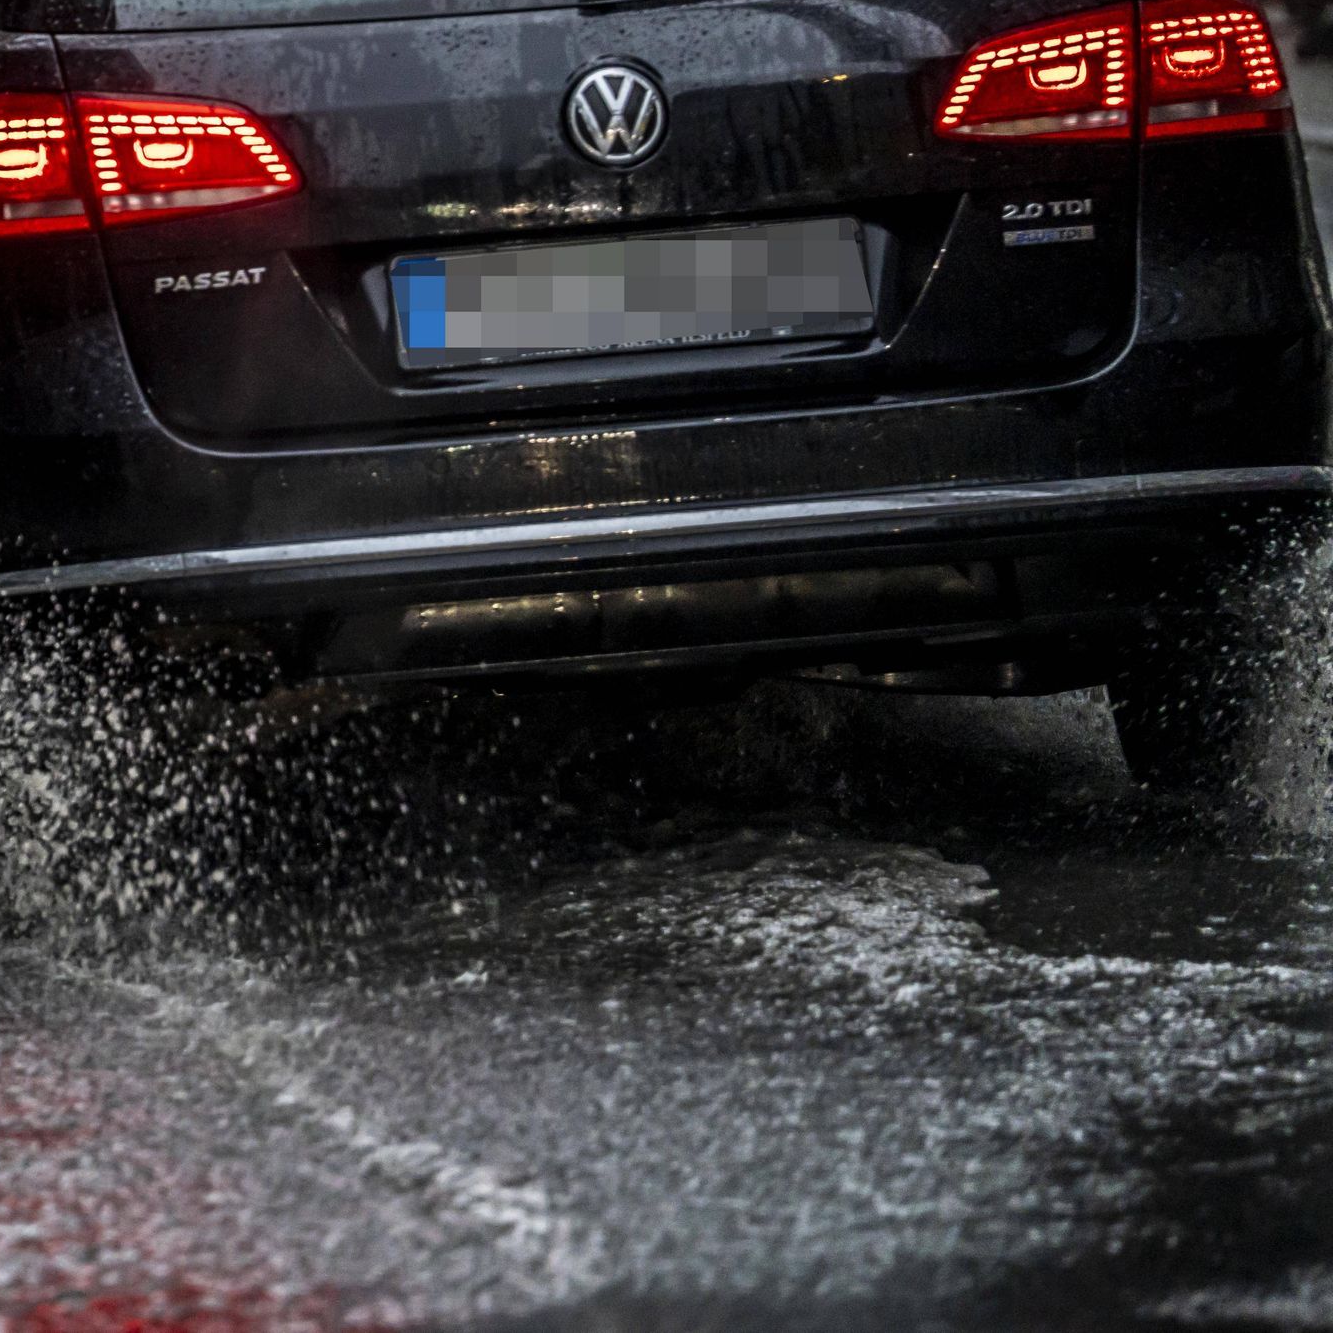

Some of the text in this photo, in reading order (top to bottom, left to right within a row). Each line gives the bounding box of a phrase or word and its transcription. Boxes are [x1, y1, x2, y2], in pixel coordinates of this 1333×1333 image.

[1002, 198, 1092, 220] 2.0 TDI
[154, 266, 266, 294] PASSAT
